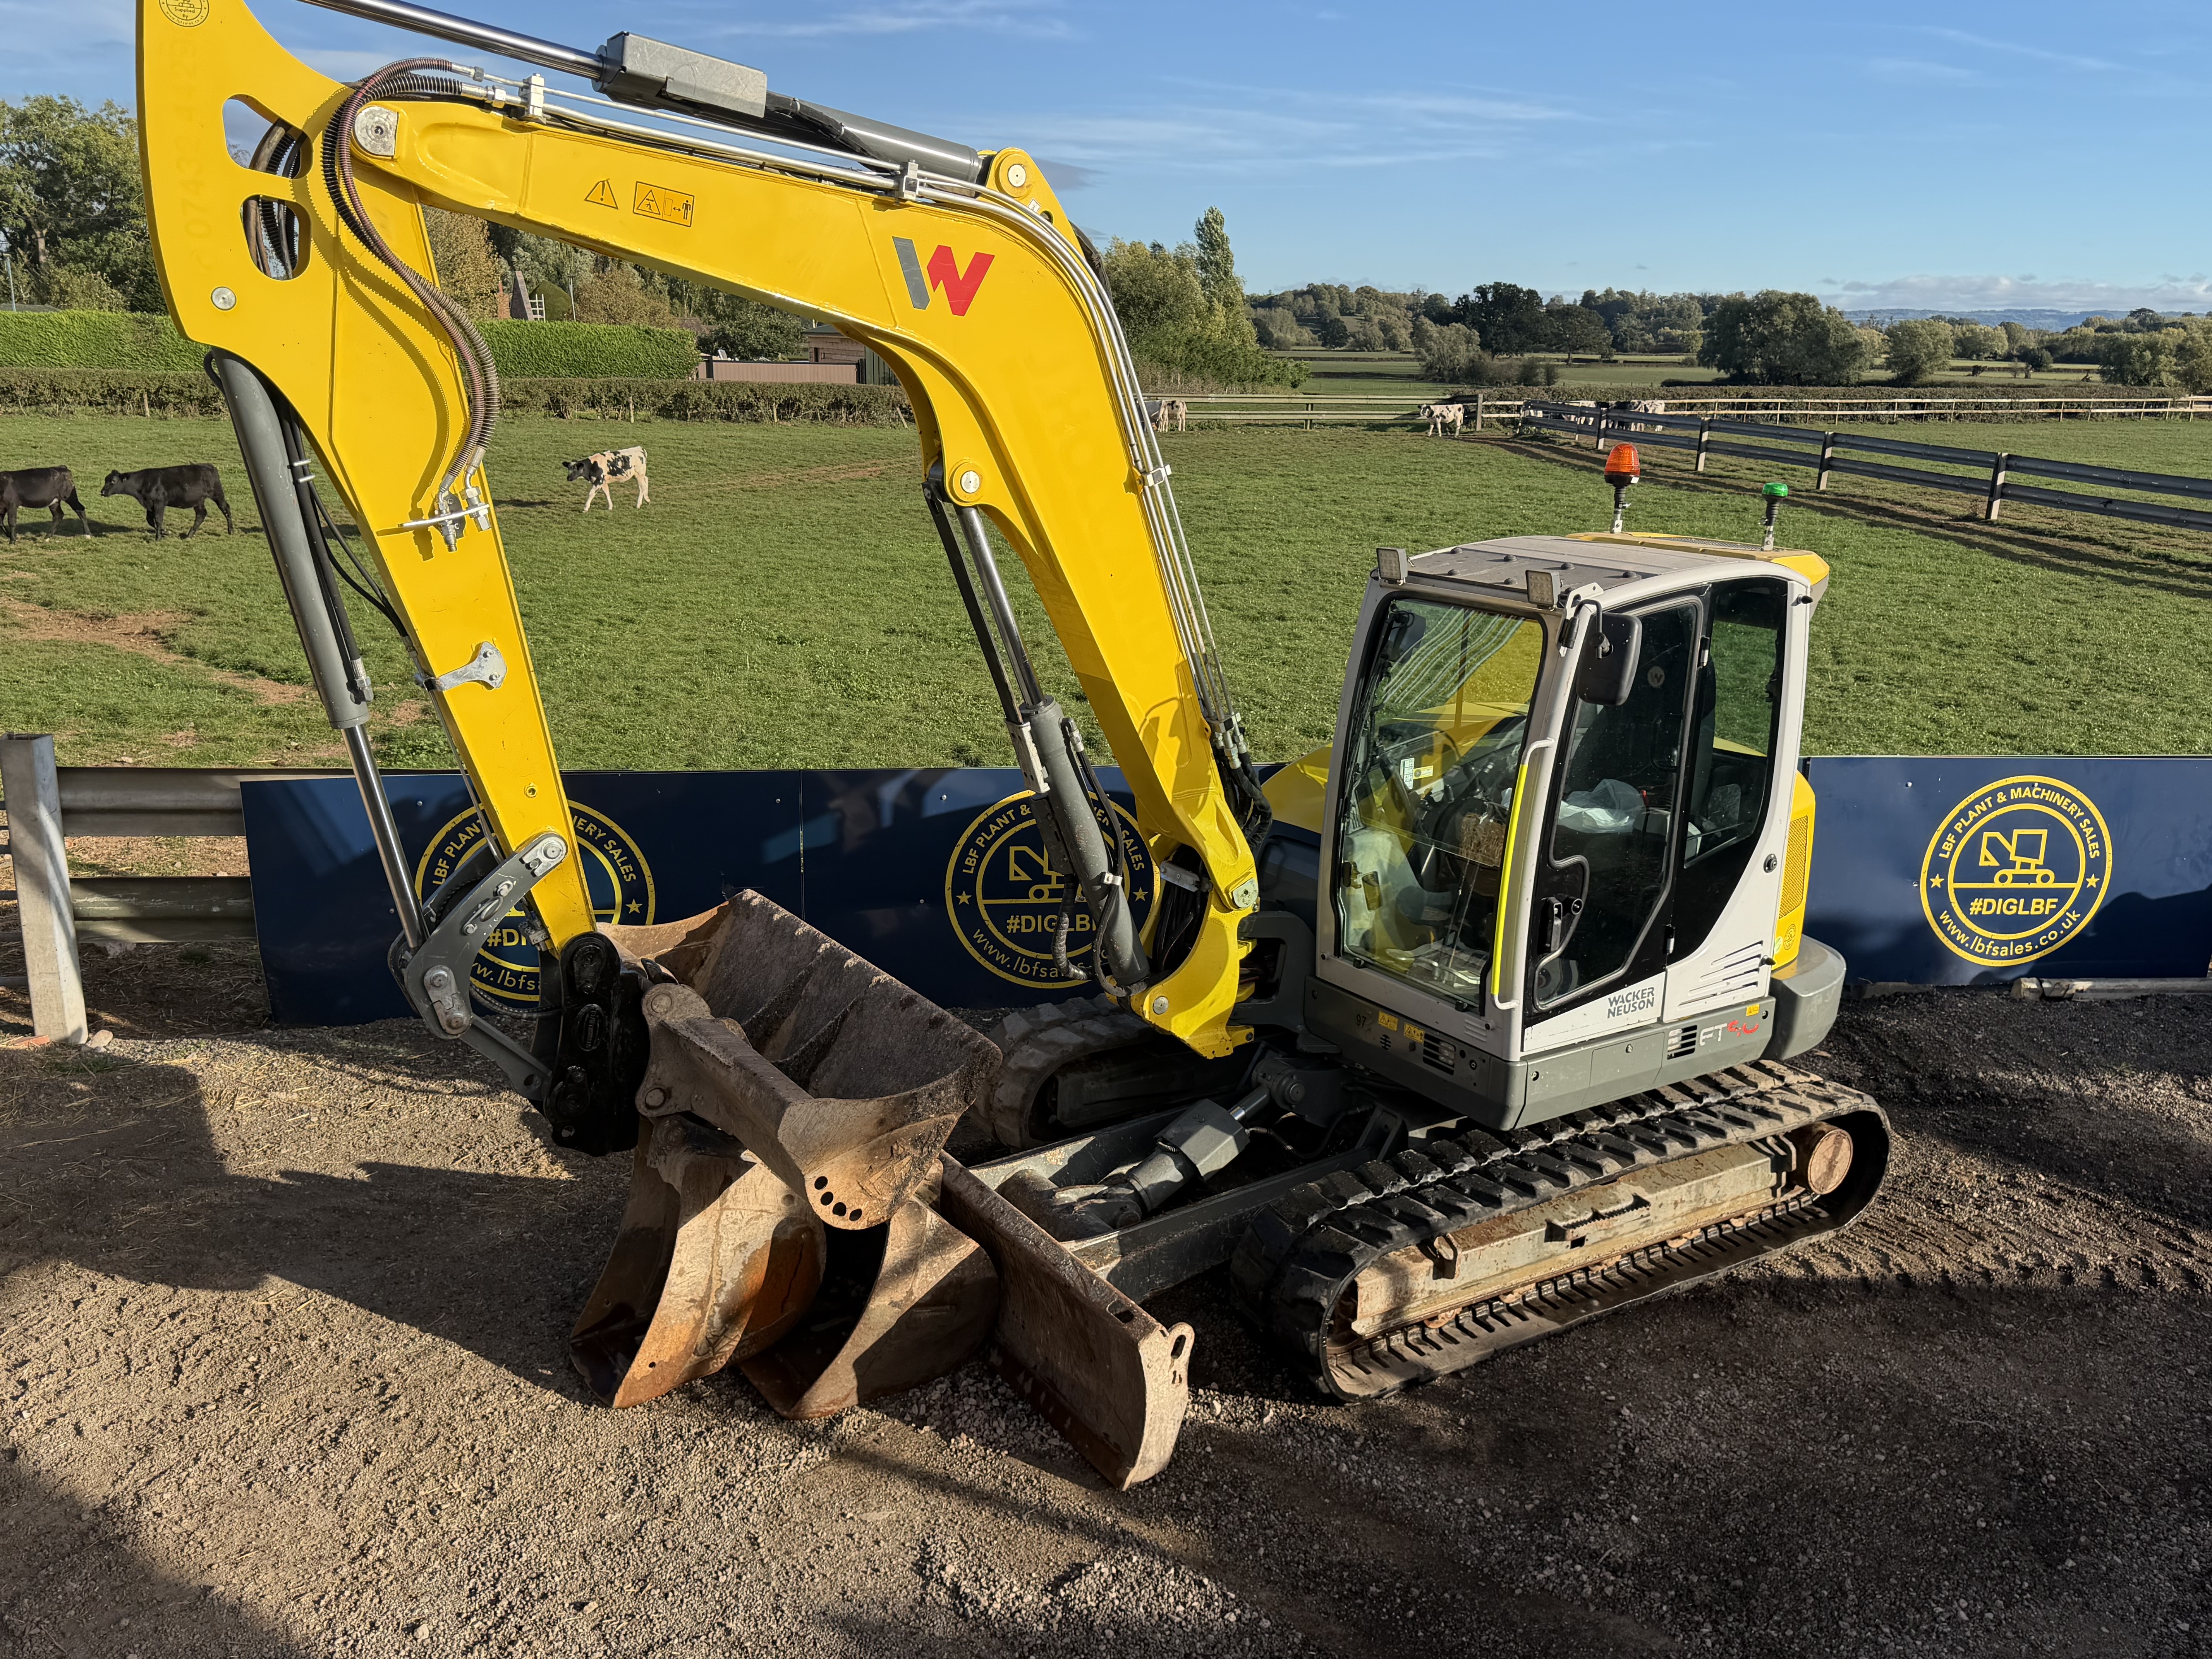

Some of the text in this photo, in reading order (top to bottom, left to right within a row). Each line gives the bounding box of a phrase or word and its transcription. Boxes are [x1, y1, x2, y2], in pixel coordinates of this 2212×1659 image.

[963, 804, 1032, 874] LBF PLANT &
[1939, 787, 2100, 859] LBF PLANT & MACHINERY SALES
[604, 840, 636, 882] SALES
[1121, 830, 1145, 871] SALES
[433, 858, 450, 885] LBF
[1970, 898, 2058, 915] #DIGLBF
[1939, 910, 2081, 957] www.lbfsales.co.uk
[1607, 997, 1654, 1018] NEUSON
[1608, 987, 1654, 1007] WACKER
[1356, 1014, 1367, 1027] 97
